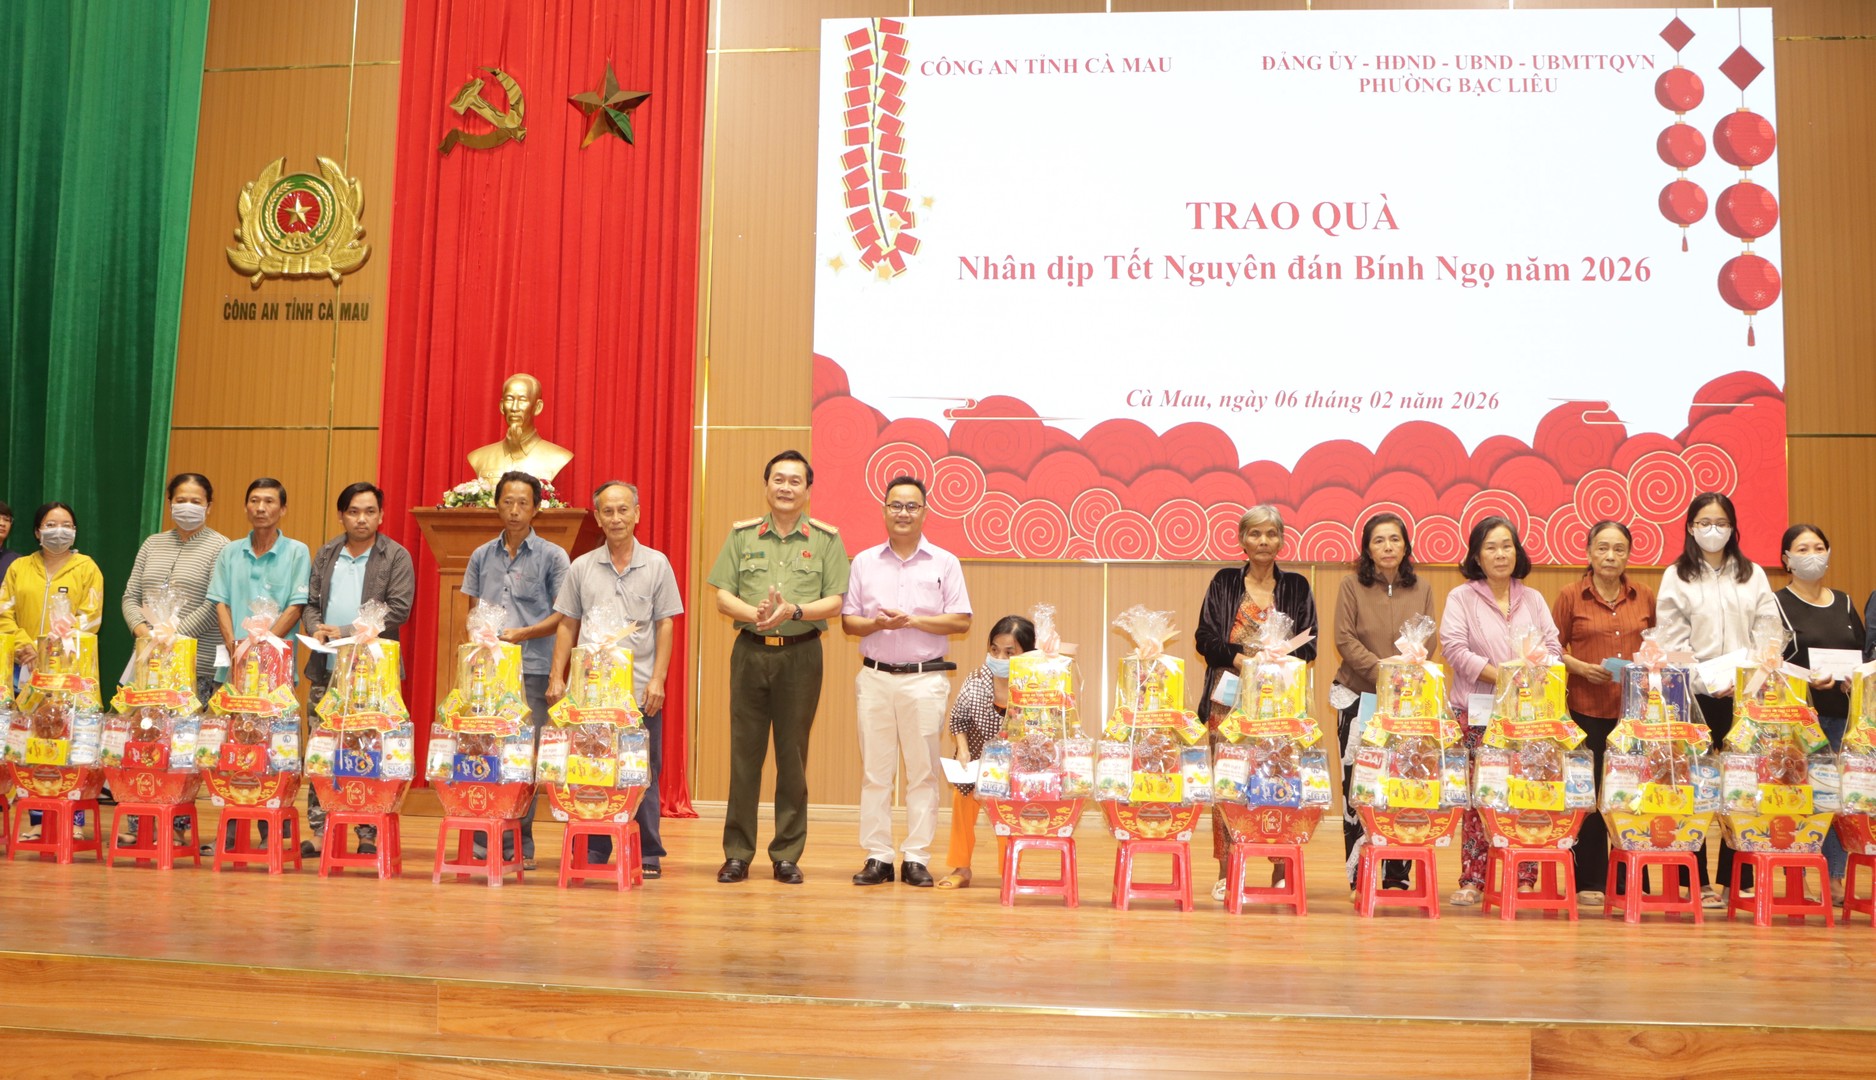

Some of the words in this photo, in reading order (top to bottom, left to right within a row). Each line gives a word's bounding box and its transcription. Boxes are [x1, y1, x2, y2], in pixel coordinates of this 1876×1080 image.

[920, 56, 983, 77] CÔNG
[988, 59, 1018, 75] AN
[1024, 54, 1078, 75] TỈNH
[1084, 53, 1115, 74] CÀ
[1122, 57, 1173, 73] MAU
[1261, 51, 1322, 71] ĐẢNG
[1329, 51, 1357, 71] ỦY
[1375, 55, 1437, 71] HĐND
[1455, 55, 1514, 71] UBND
[1532, 54, 1655, 72] UBMTTQVN
[1359, 73, 1452, 93] PHƯỜNG
[1459, 77, 1502, 97] BẠC
[1508, 73, 1559, 93] LIÊU
[1186, 201, 1300, 231] TRAO
[1312, 193, 1399, 238] QUÀ
[958, 254, 1036, 281] Nhân
[1047, 254, 1094, 288] dịp
[1104, 247, 1153, 281] Tết
[1164, 254, 1277, 288] Nguyên
[1287, 254, 1343, 281] đán
[1355, 253, 1425, 281] Bính
[1436, 255, 1495, 289] Ngọ
[1506, 254, 1570, 282] năm
[1582, 256, 1652, 283] 2026
[223, 298, 257, 321] CÔNG
[261, 302, 280, 321] AN
[318, 299, 334, 321] CÀ
[339, 302, 369, 322] MAU
[1125, 389, 1153, 408] Cà
[1160, 389, 1212, 410] Mau,
[1218, 390, 1268, 413] ngày
[1274, 390, 1299, 408] 06
[1304, 389, 1363, 413] tháng
[1369, 390, 1394, 409] 02
[1400, 391, 1444, 409] năm
[1451, 391, 1500, 410] 2026
